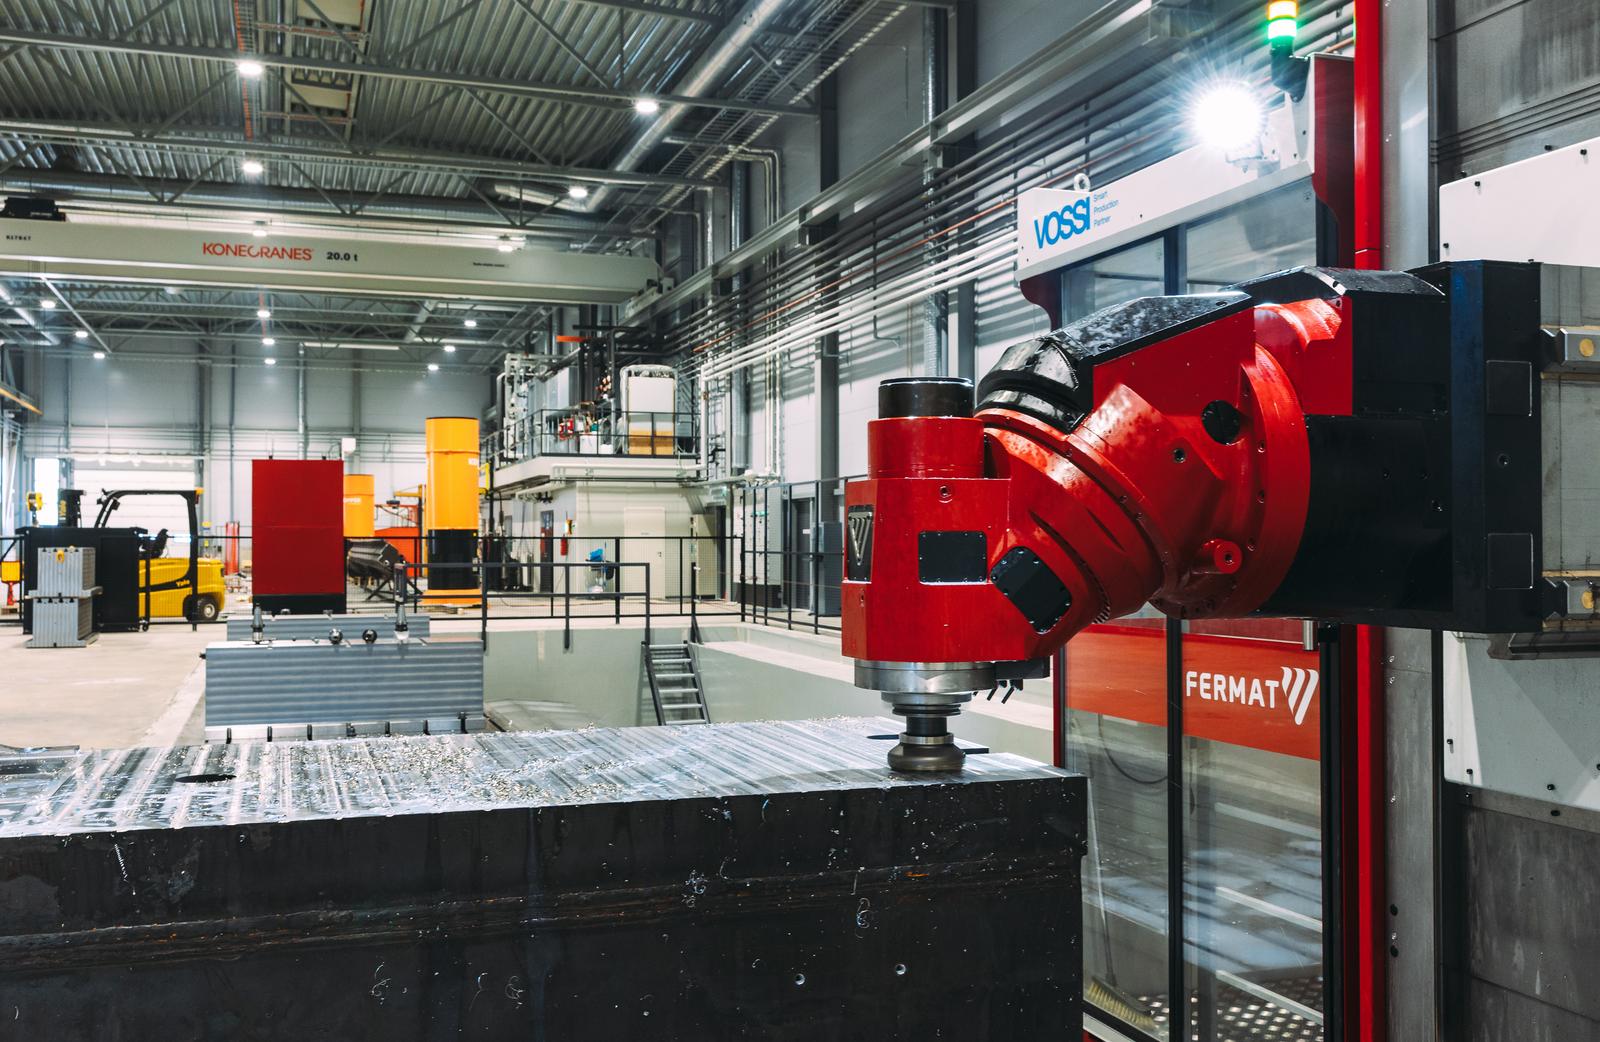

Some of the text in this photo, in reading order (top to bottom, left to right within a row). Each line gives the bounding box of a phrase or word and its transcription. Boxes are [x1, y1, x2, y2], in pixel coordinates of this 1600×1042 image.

[1093, 199, 1120, 215] Production
[1034, 196, 1090, 249] VOSSI
[1093, 215, 1112, 228] Partner
[202, 242, 313, 262] KONECRANES
[326, 251, 359, 262] 20.0 t
[1185, 670, 1280, 709] FERMAT
